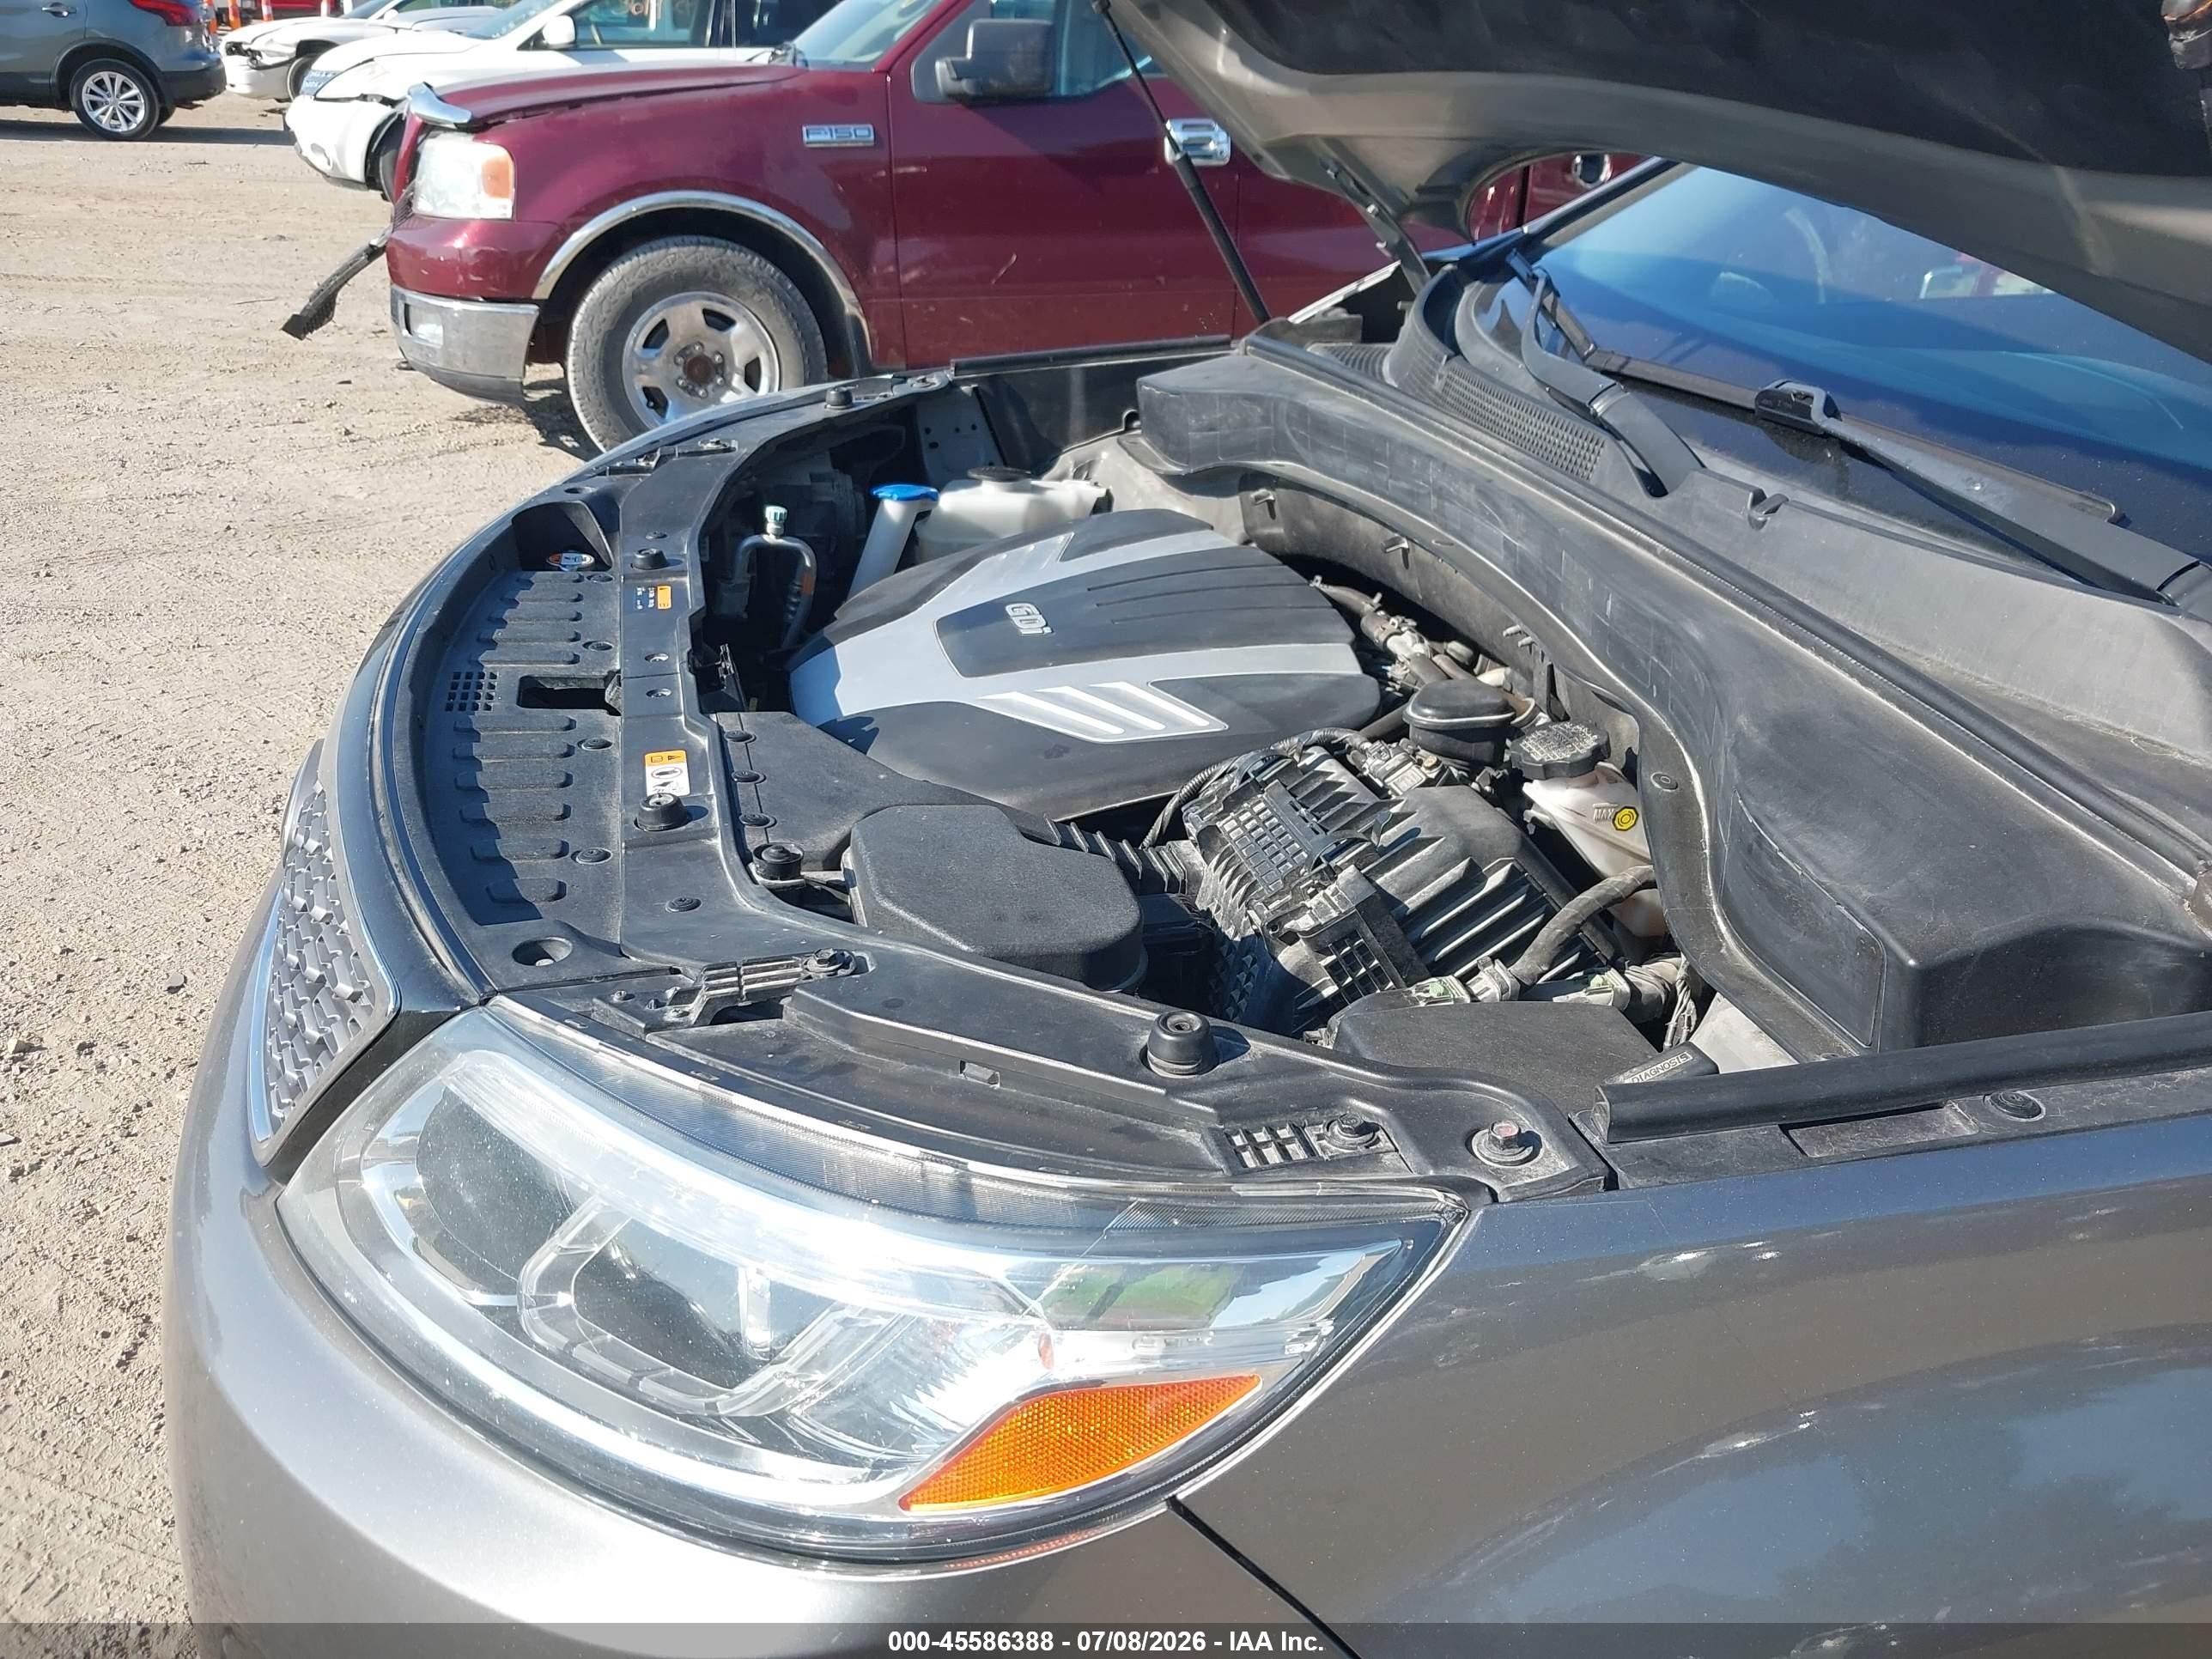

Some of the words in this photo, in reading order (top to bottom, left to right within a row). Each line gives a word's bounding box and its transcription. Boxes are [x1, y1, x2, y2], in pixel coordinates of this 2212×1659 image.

[1005, 602, 1053, 635] GDi
[1593, 808, 1615, 822] MAX
[1631, 1053, 1689, 1083] DIAGNOSIS
